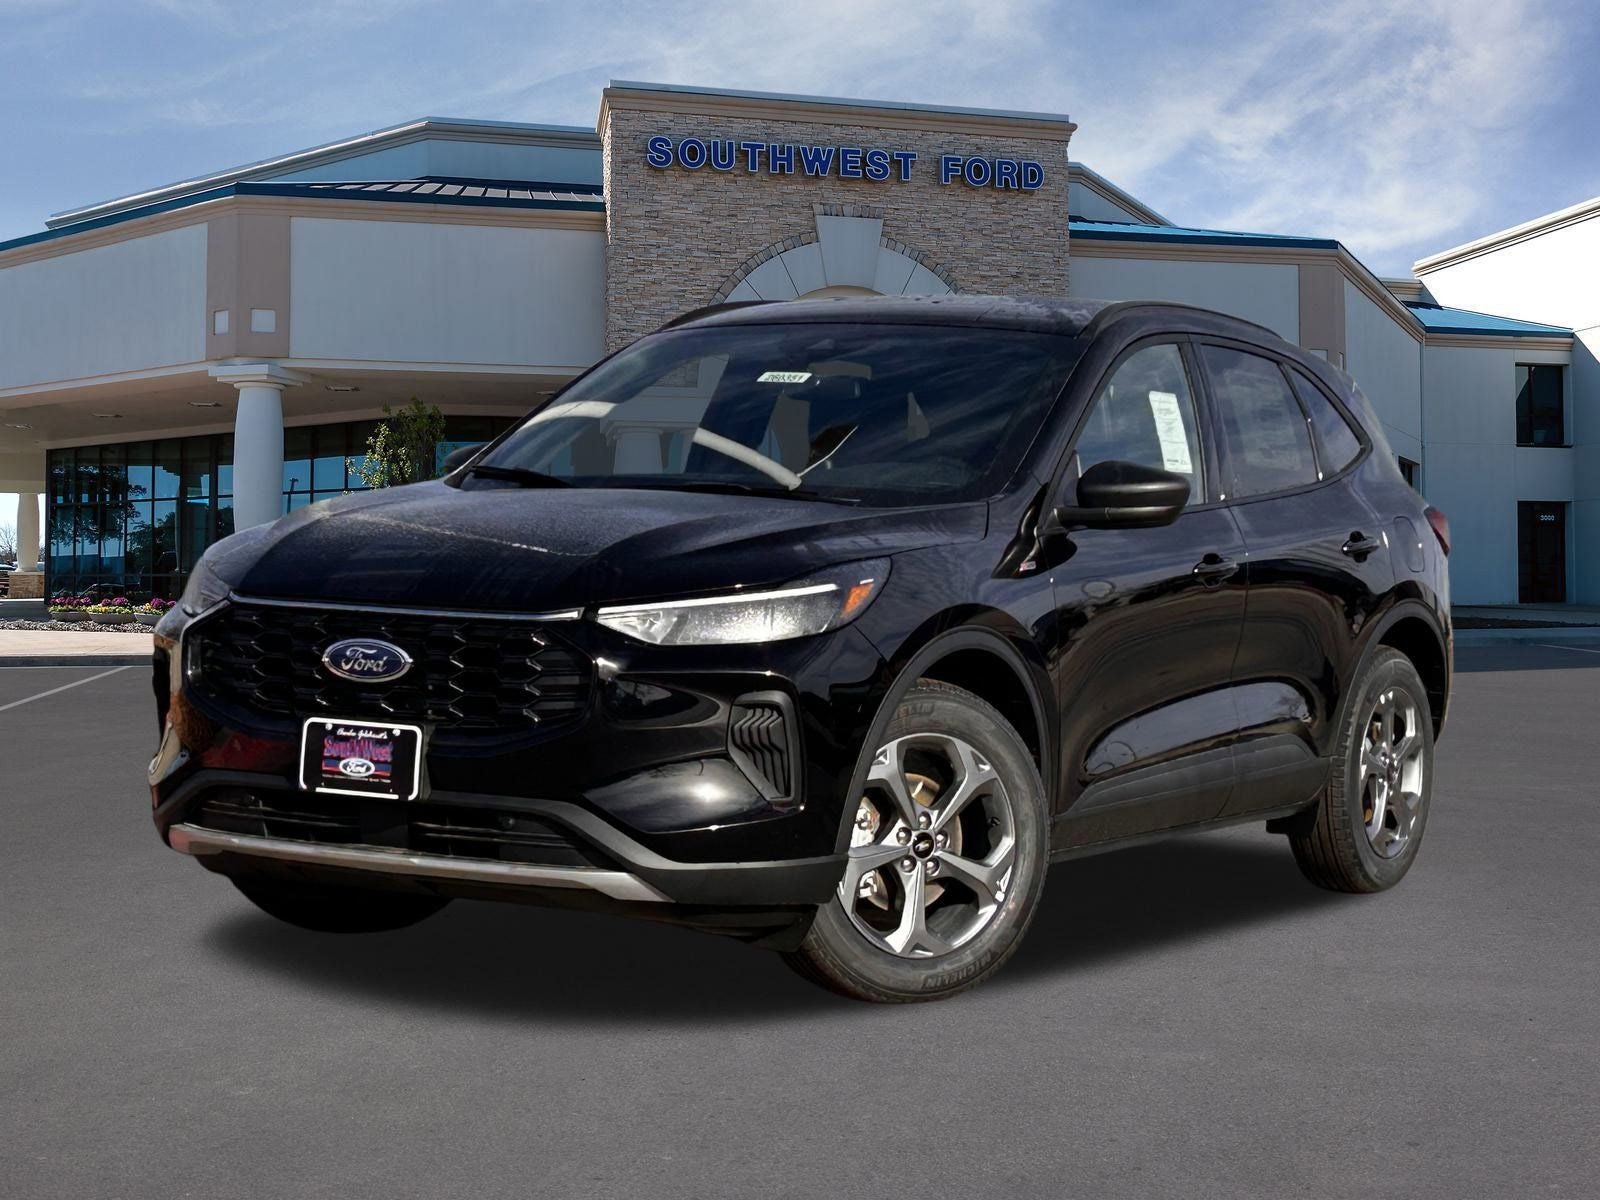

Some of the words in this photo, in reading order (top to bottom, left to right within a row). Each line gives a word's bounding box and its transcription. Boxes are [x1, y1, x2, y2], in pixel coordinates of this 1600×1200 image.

[647, 135, 918, 182] SOUTHWEST
[940, 155, 1046, 190] FORD
[341, 646, 388, 672] Ford
